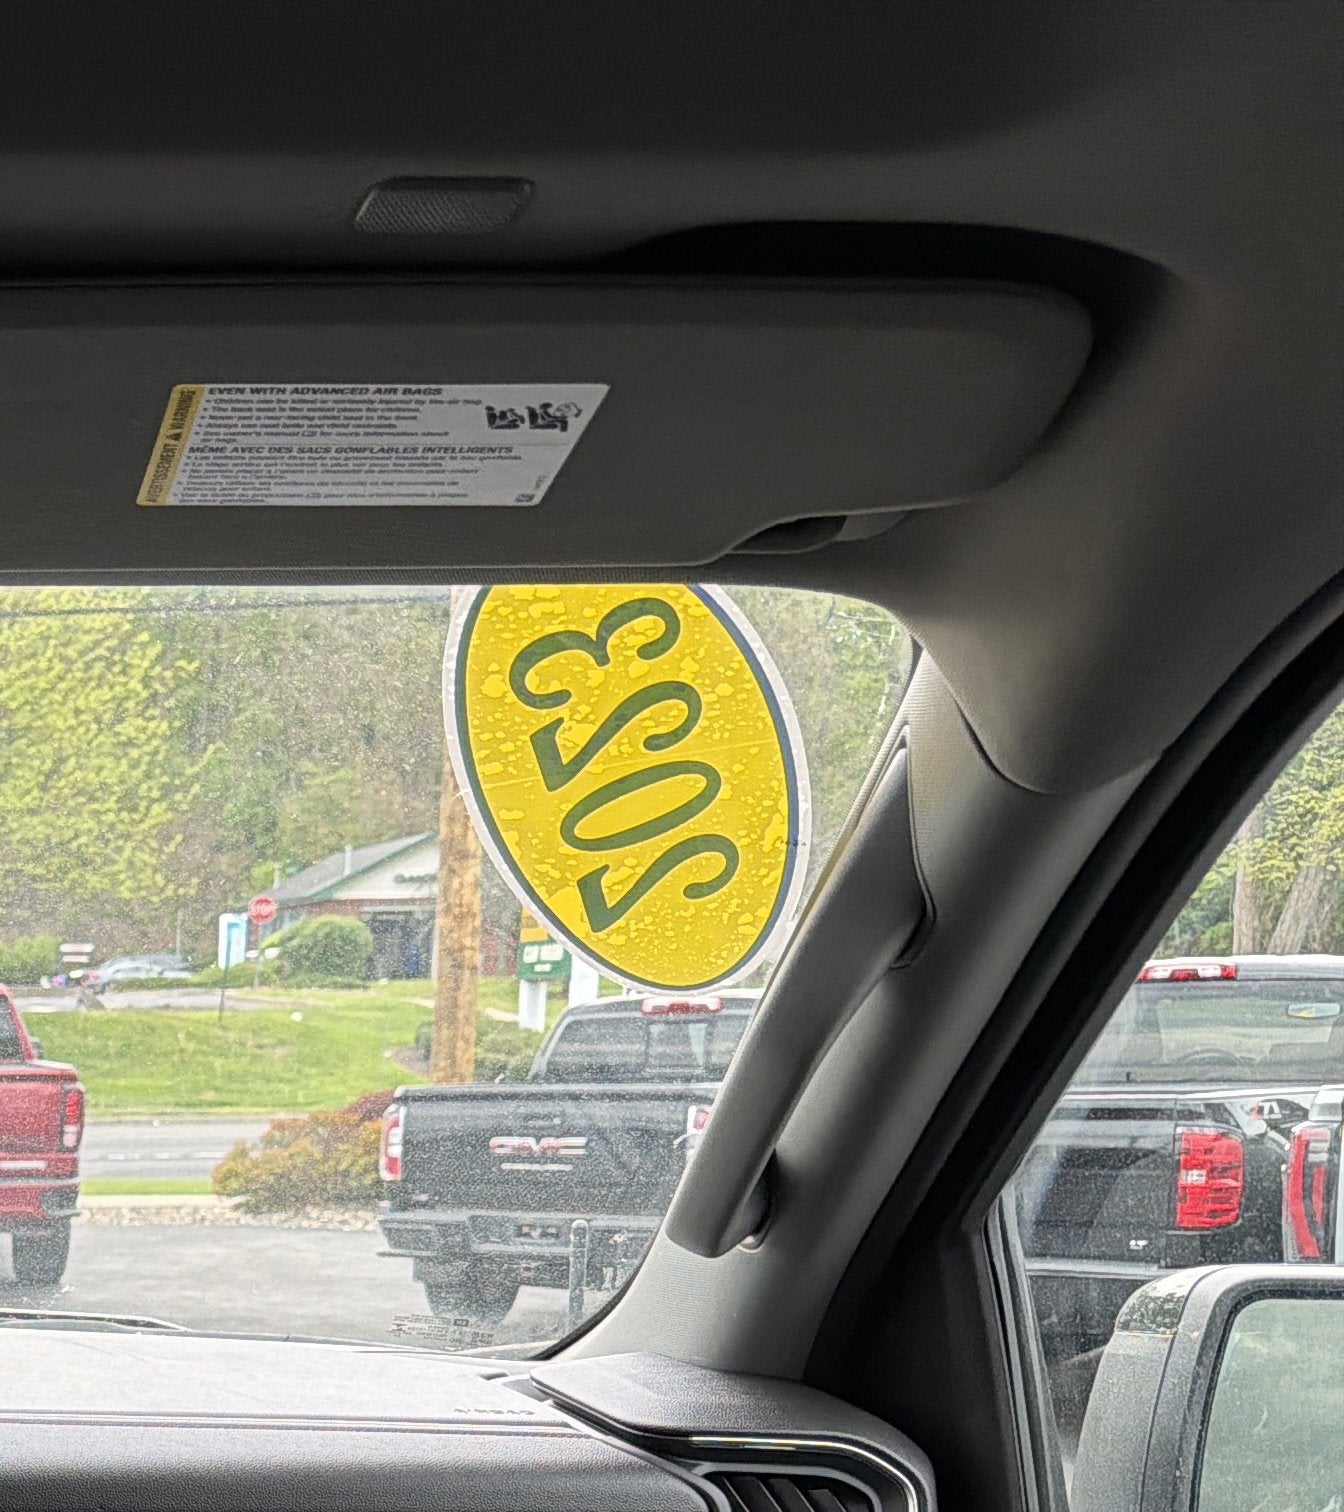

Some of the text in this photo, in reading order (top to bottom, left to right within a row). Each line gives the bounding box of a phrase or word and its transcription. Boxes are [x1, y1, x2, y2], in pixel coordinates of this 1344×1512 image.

[208, 387, 443, 396] EVEN WITH ADVANCED AIR BAGS
[189, 444, 514, 455] MÊME AVEC DES SACS GONFLABLES INTELLIGENTS
[489, 1136, 589, 1156] GMC
